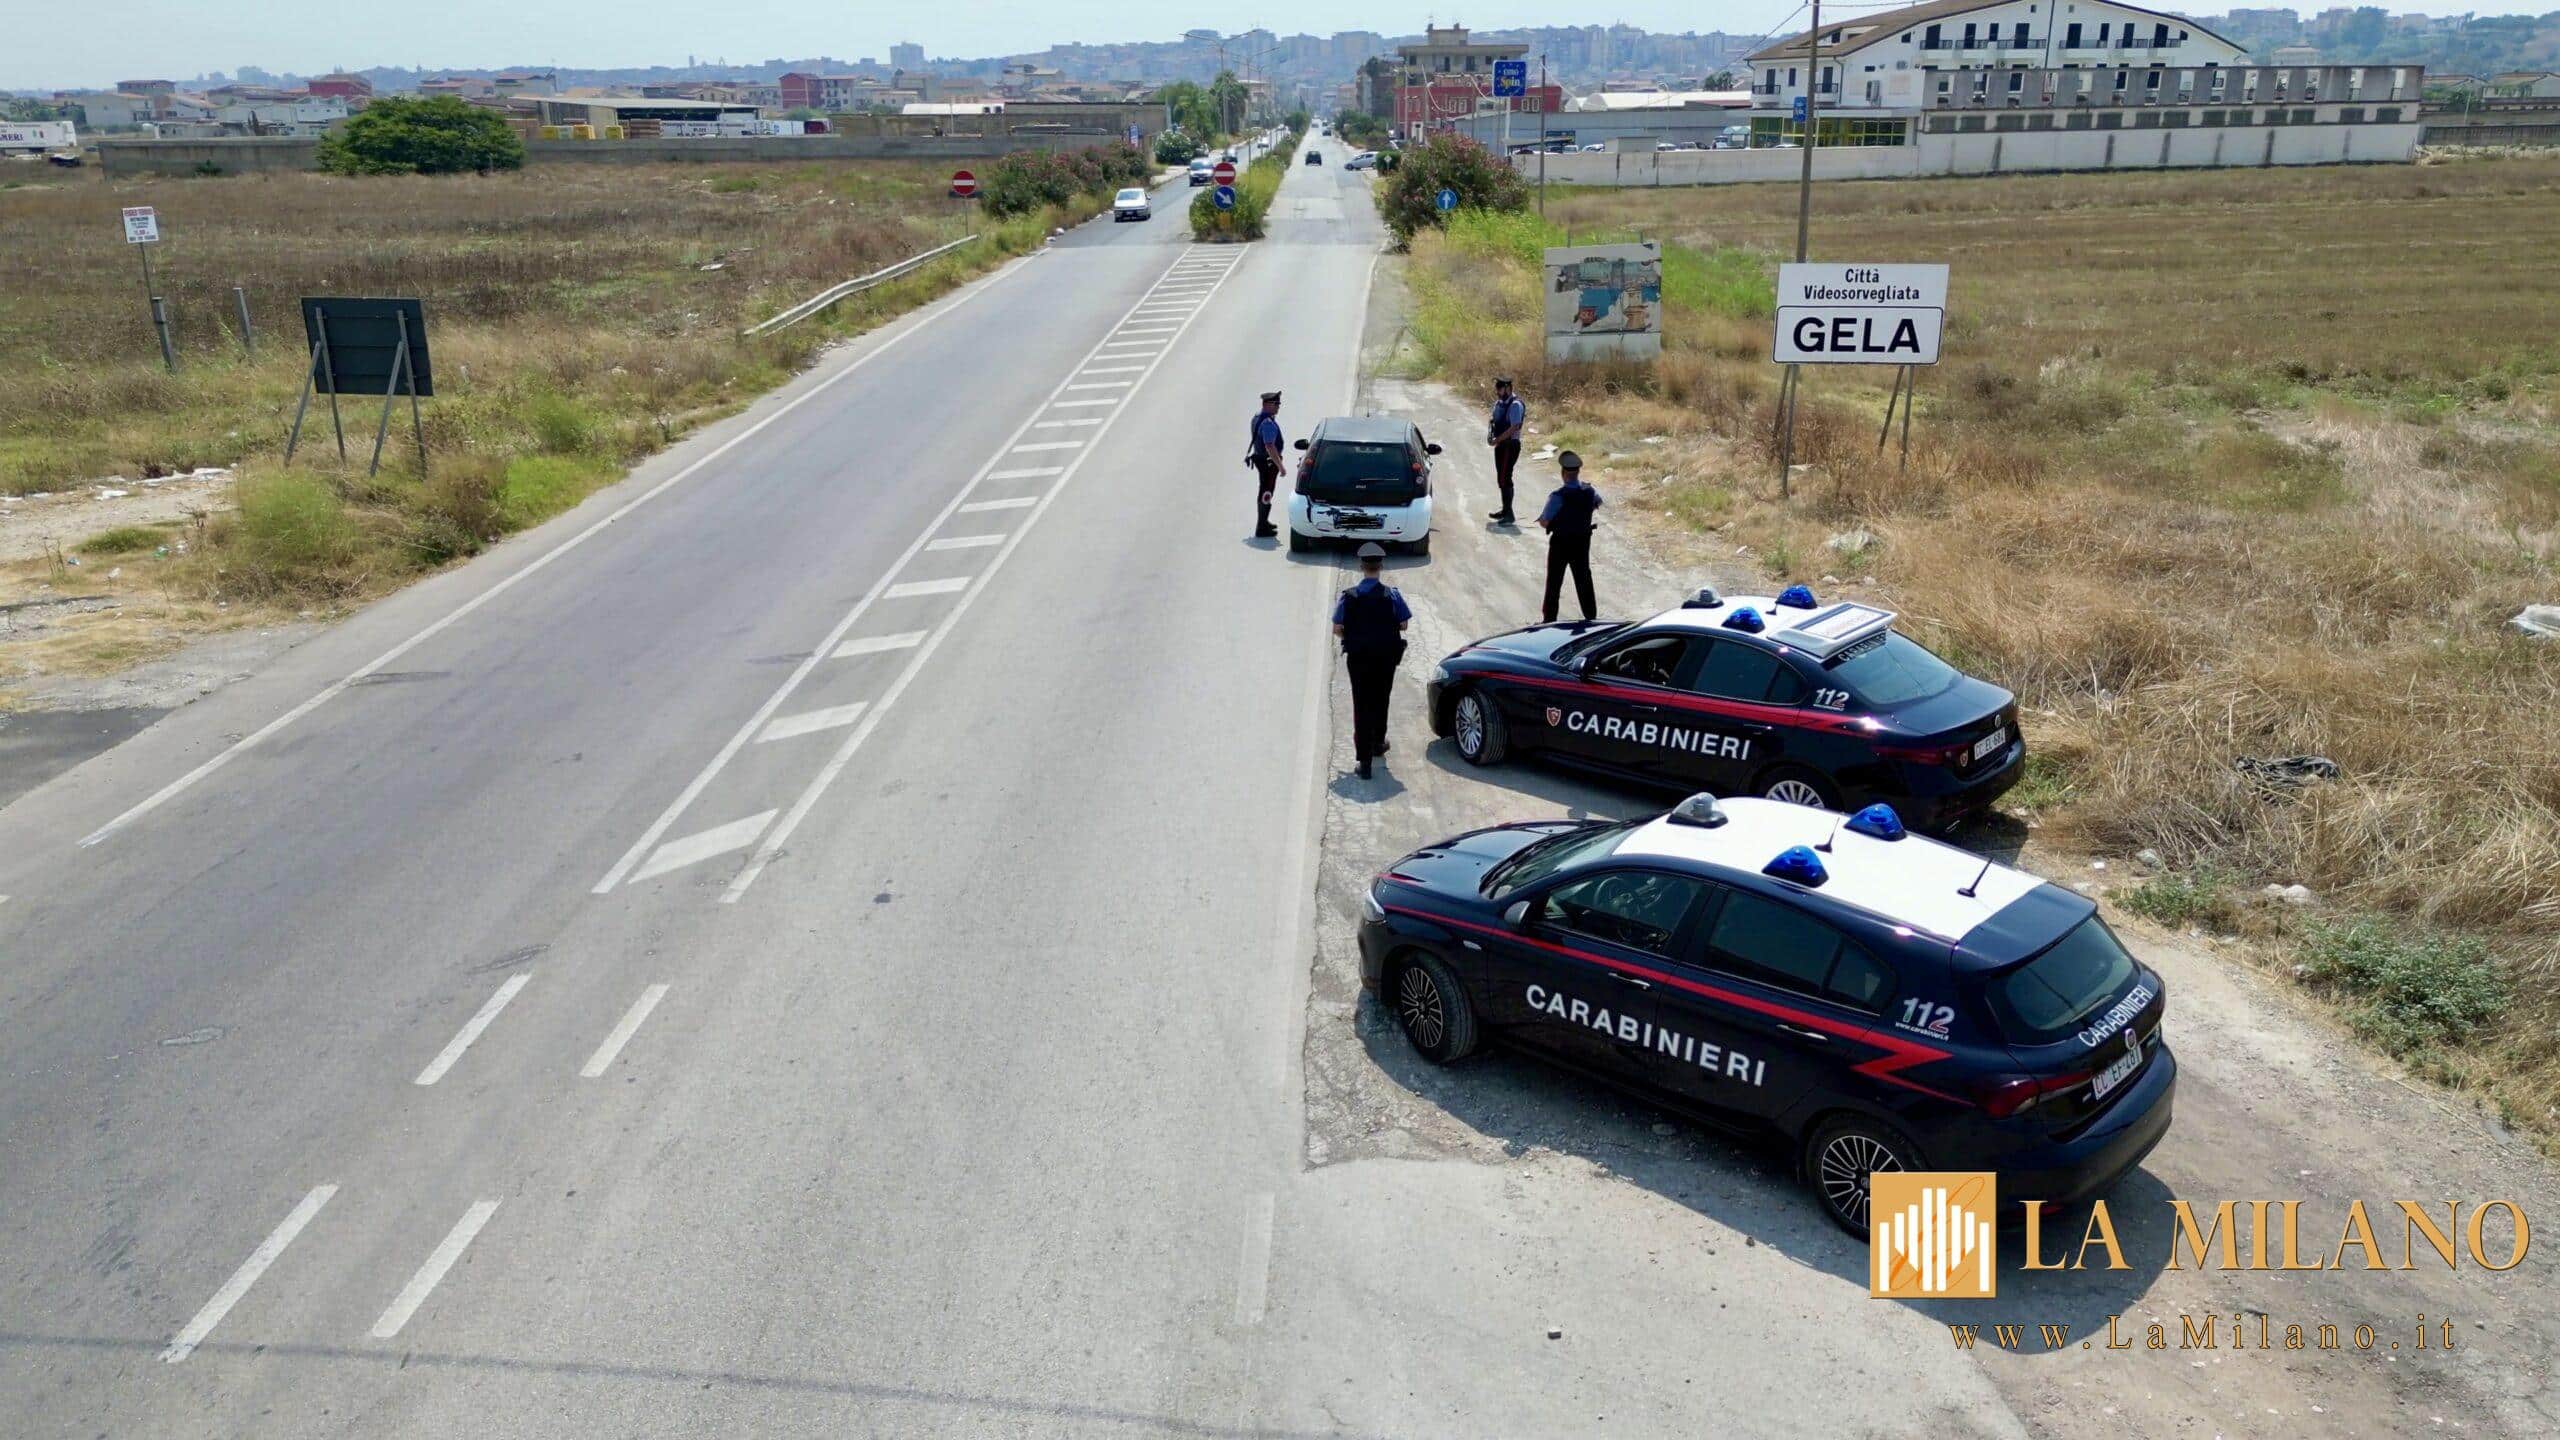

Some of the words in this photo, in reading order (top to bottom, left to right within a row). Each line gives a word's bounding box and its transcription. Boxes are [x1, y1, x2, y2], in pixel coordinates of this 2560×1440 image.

[1804, 285, 1920, 303] Videosorvegliata
[1845, 268, 1880, 283] Città
[1793, 316, 1921, 353] GELA
[1815, 688, 1850, 709] 112
[1567, 711, 1751, 761] CARABINIERI
[1902, 997, 1955, 1034] 112
[2078, 984, 2154, 1047] CARABINIERI
[1526, 984, 1766, 1087] CARABINIERI
